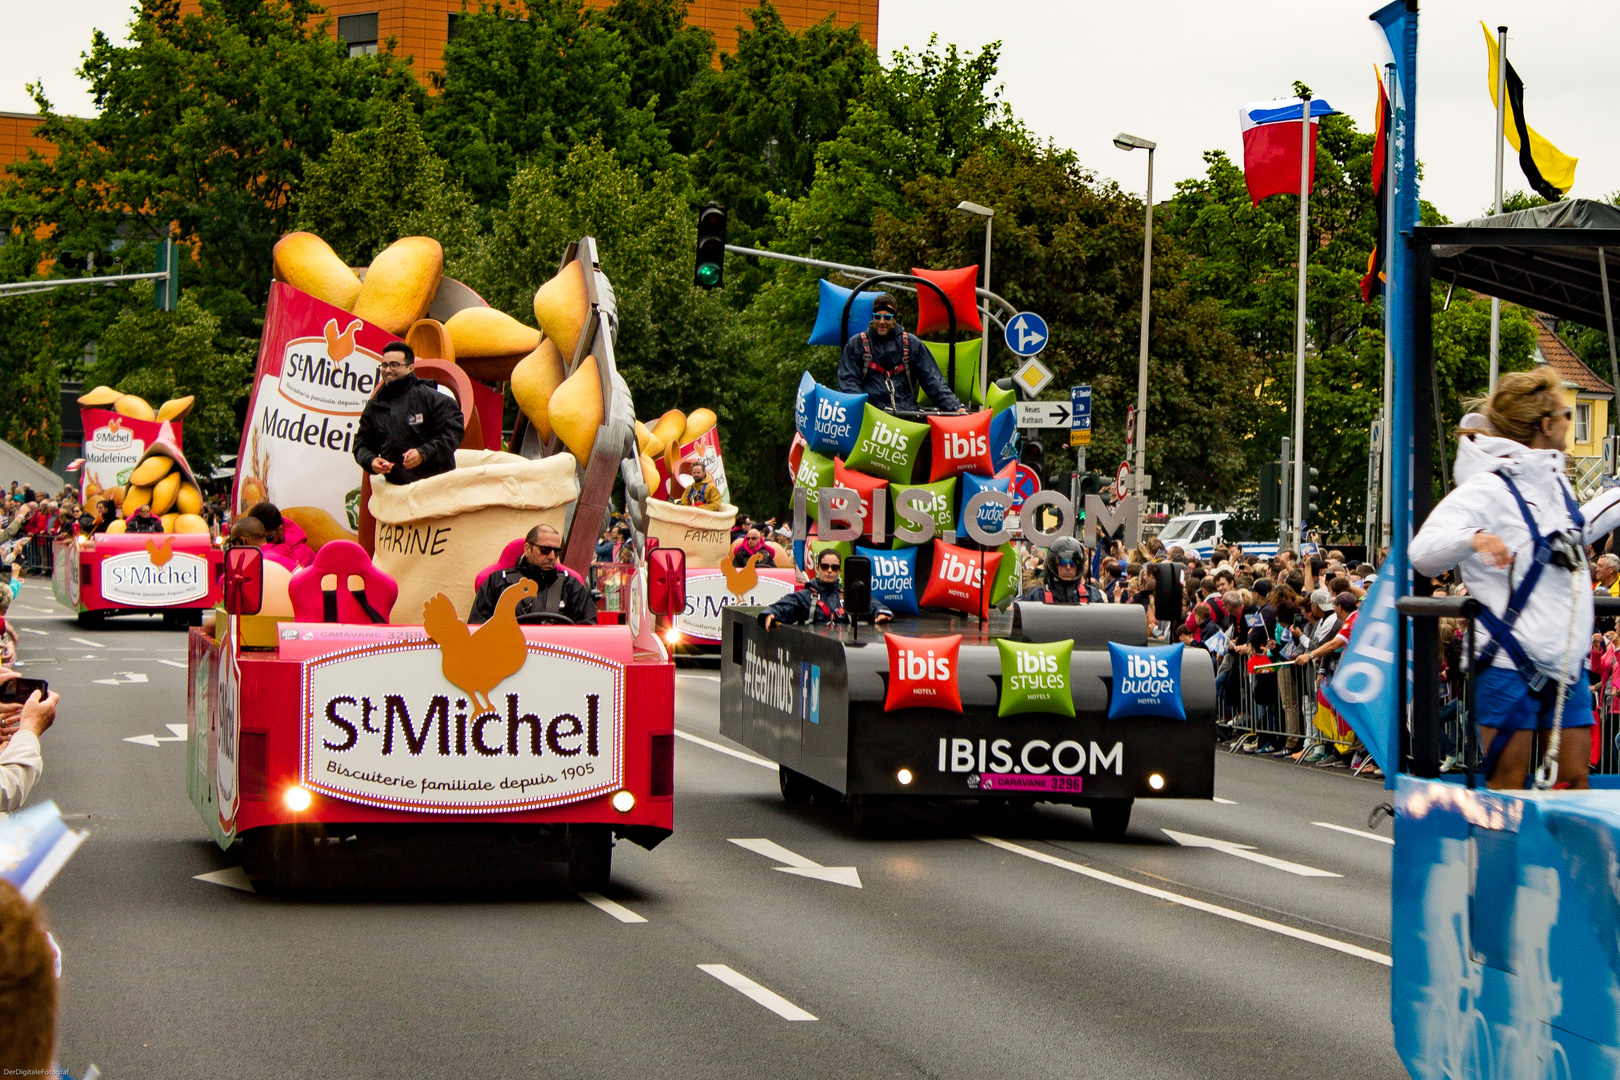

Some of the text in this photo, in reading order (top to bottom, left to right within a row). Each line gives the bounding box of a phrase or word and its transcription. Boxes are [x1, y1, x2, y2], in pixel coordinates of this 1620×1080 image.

[817, 398, 846, 423] ibis
[1022, 416, 1043, 424] Rathaus
[261, 406, 356, 452] Madelei
[815, 418, 851, 438] budget
[871, 420, 909, 451] ibis
[943, 431, 987, 460] ibis
[87, 453, 137, 463] Madeleines
[870, 460, 890, 471] HOTELS
[797, 459, 819, 488] ibis
[793, 487, 1138, 550] IBIS.COM
[873, 556, 909, 577] ibis
[939, 552, 987, 589] ibis
[871, 575, 913, 593] budget
[948, 588, 969, 599] HOTELS
[320, 631, 381, 639] CARAVANE
[898, 650, 950, 681] ibis
[1016, 651, 1058, 674] ibis
[1127, 655, 1169, 678] ibis
[744, 638, 794, 714] #teamibis
[1121, 677, 1175, 697] budget
[938, 738, 1123, 776] IBIS.COM
[326, 760, 595, 794] Biscuiterie familiale depuis 1905
[998, 778, 1047, 788] CARAVANE
[1051, 778, 1080, 791] 3296
